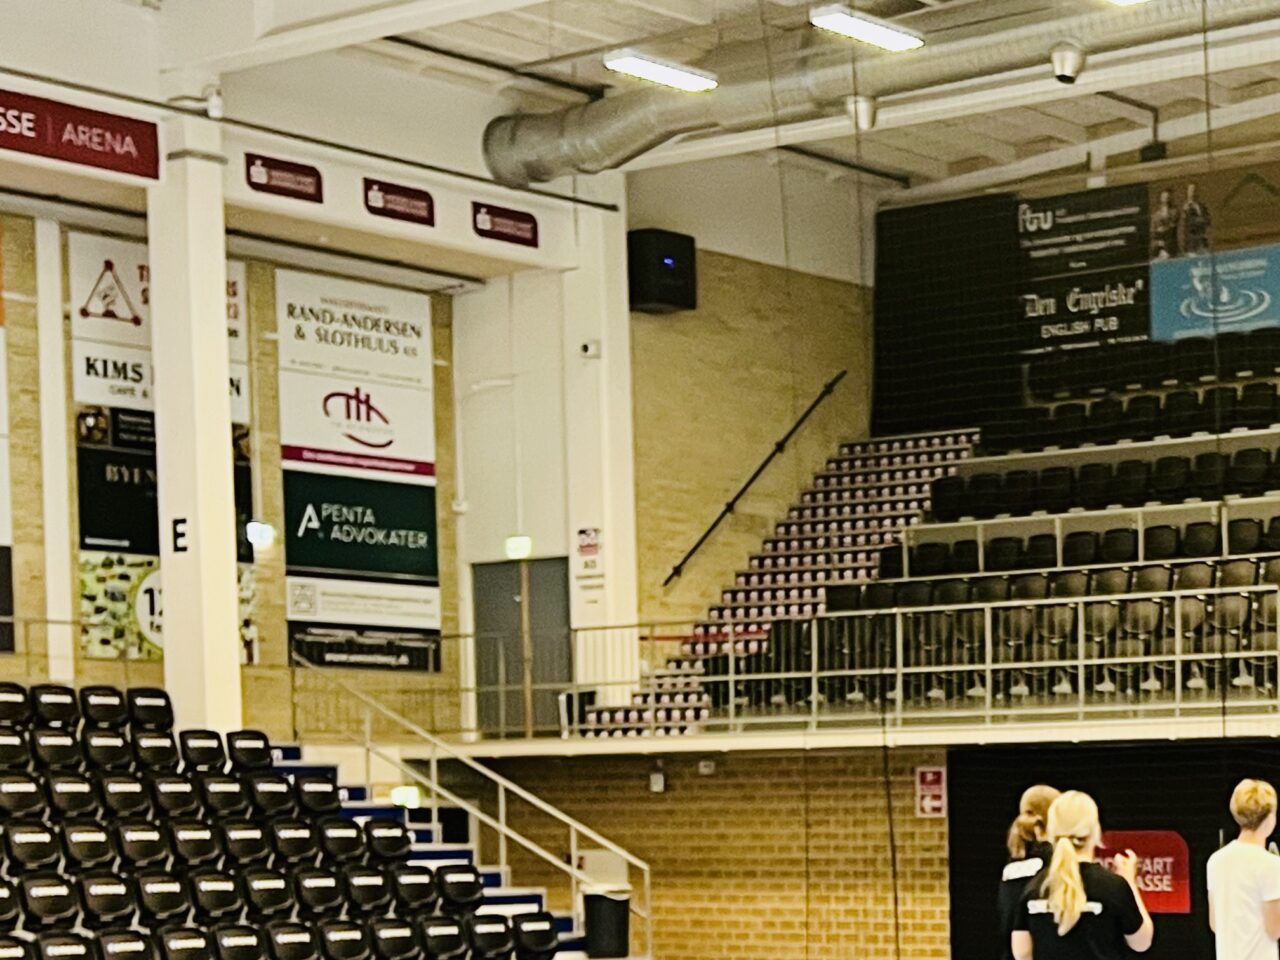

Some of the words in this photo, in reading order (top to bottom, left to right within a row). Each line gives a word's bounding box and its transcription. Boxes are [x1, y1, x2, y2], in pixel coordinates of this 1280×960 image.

[61, 122, 138, 158] ARENA
[294, 324, 306, 341] &
[85, 357, 144, 383] KIMS
[321, 503, 376, 525] PENTA
[172, 518, 188, 552] E
[331, 524, 429, 548] ADVOKATER
